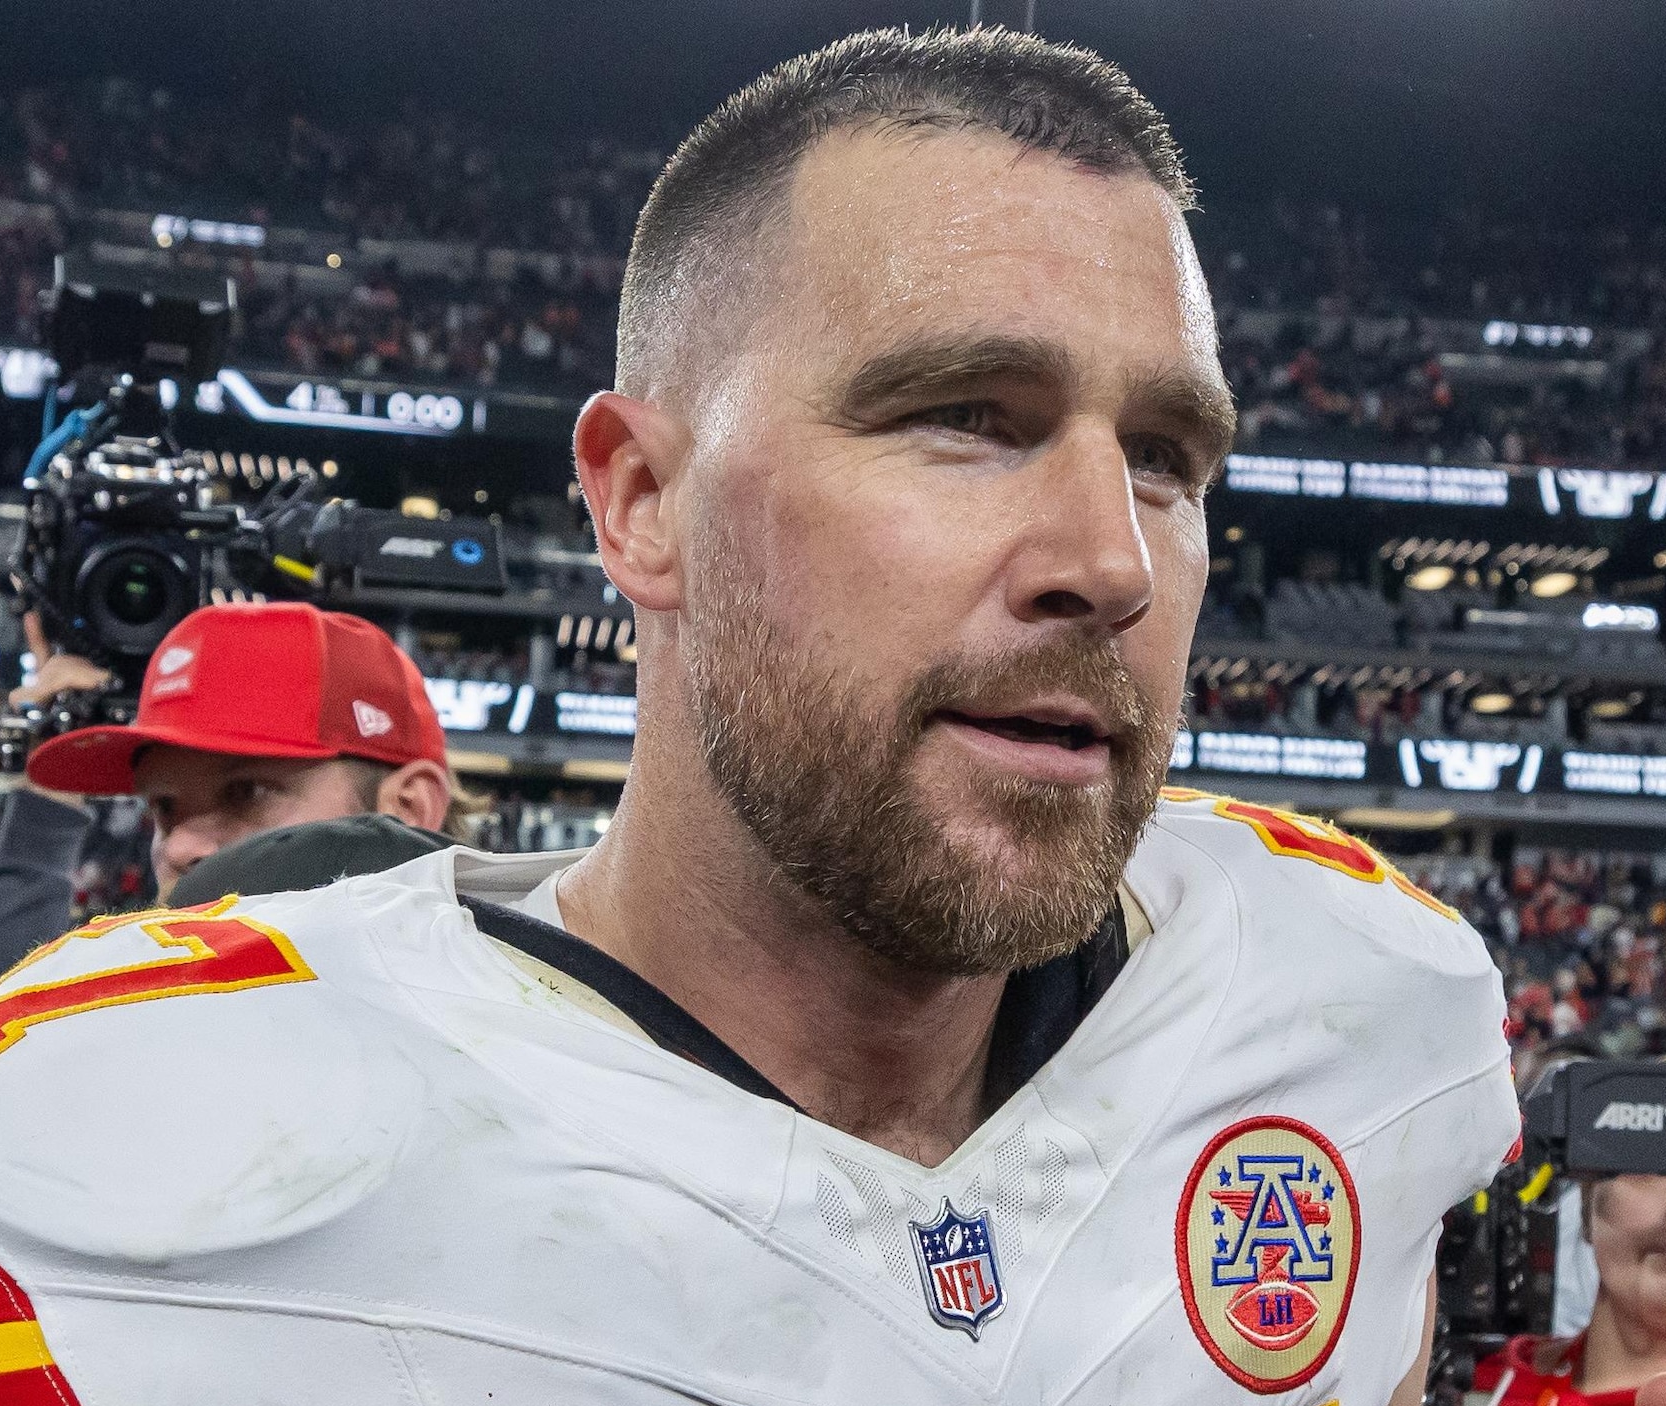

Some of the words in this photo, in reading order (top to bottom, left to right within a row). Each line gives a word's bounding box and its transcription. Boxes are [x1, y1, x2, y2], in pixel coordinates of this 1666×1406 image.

[1594, 1102, 1664, 1132] ARRI
[1212, 1155, 1334, 1287] A
[934, 1259, 996, 1313] NFL
